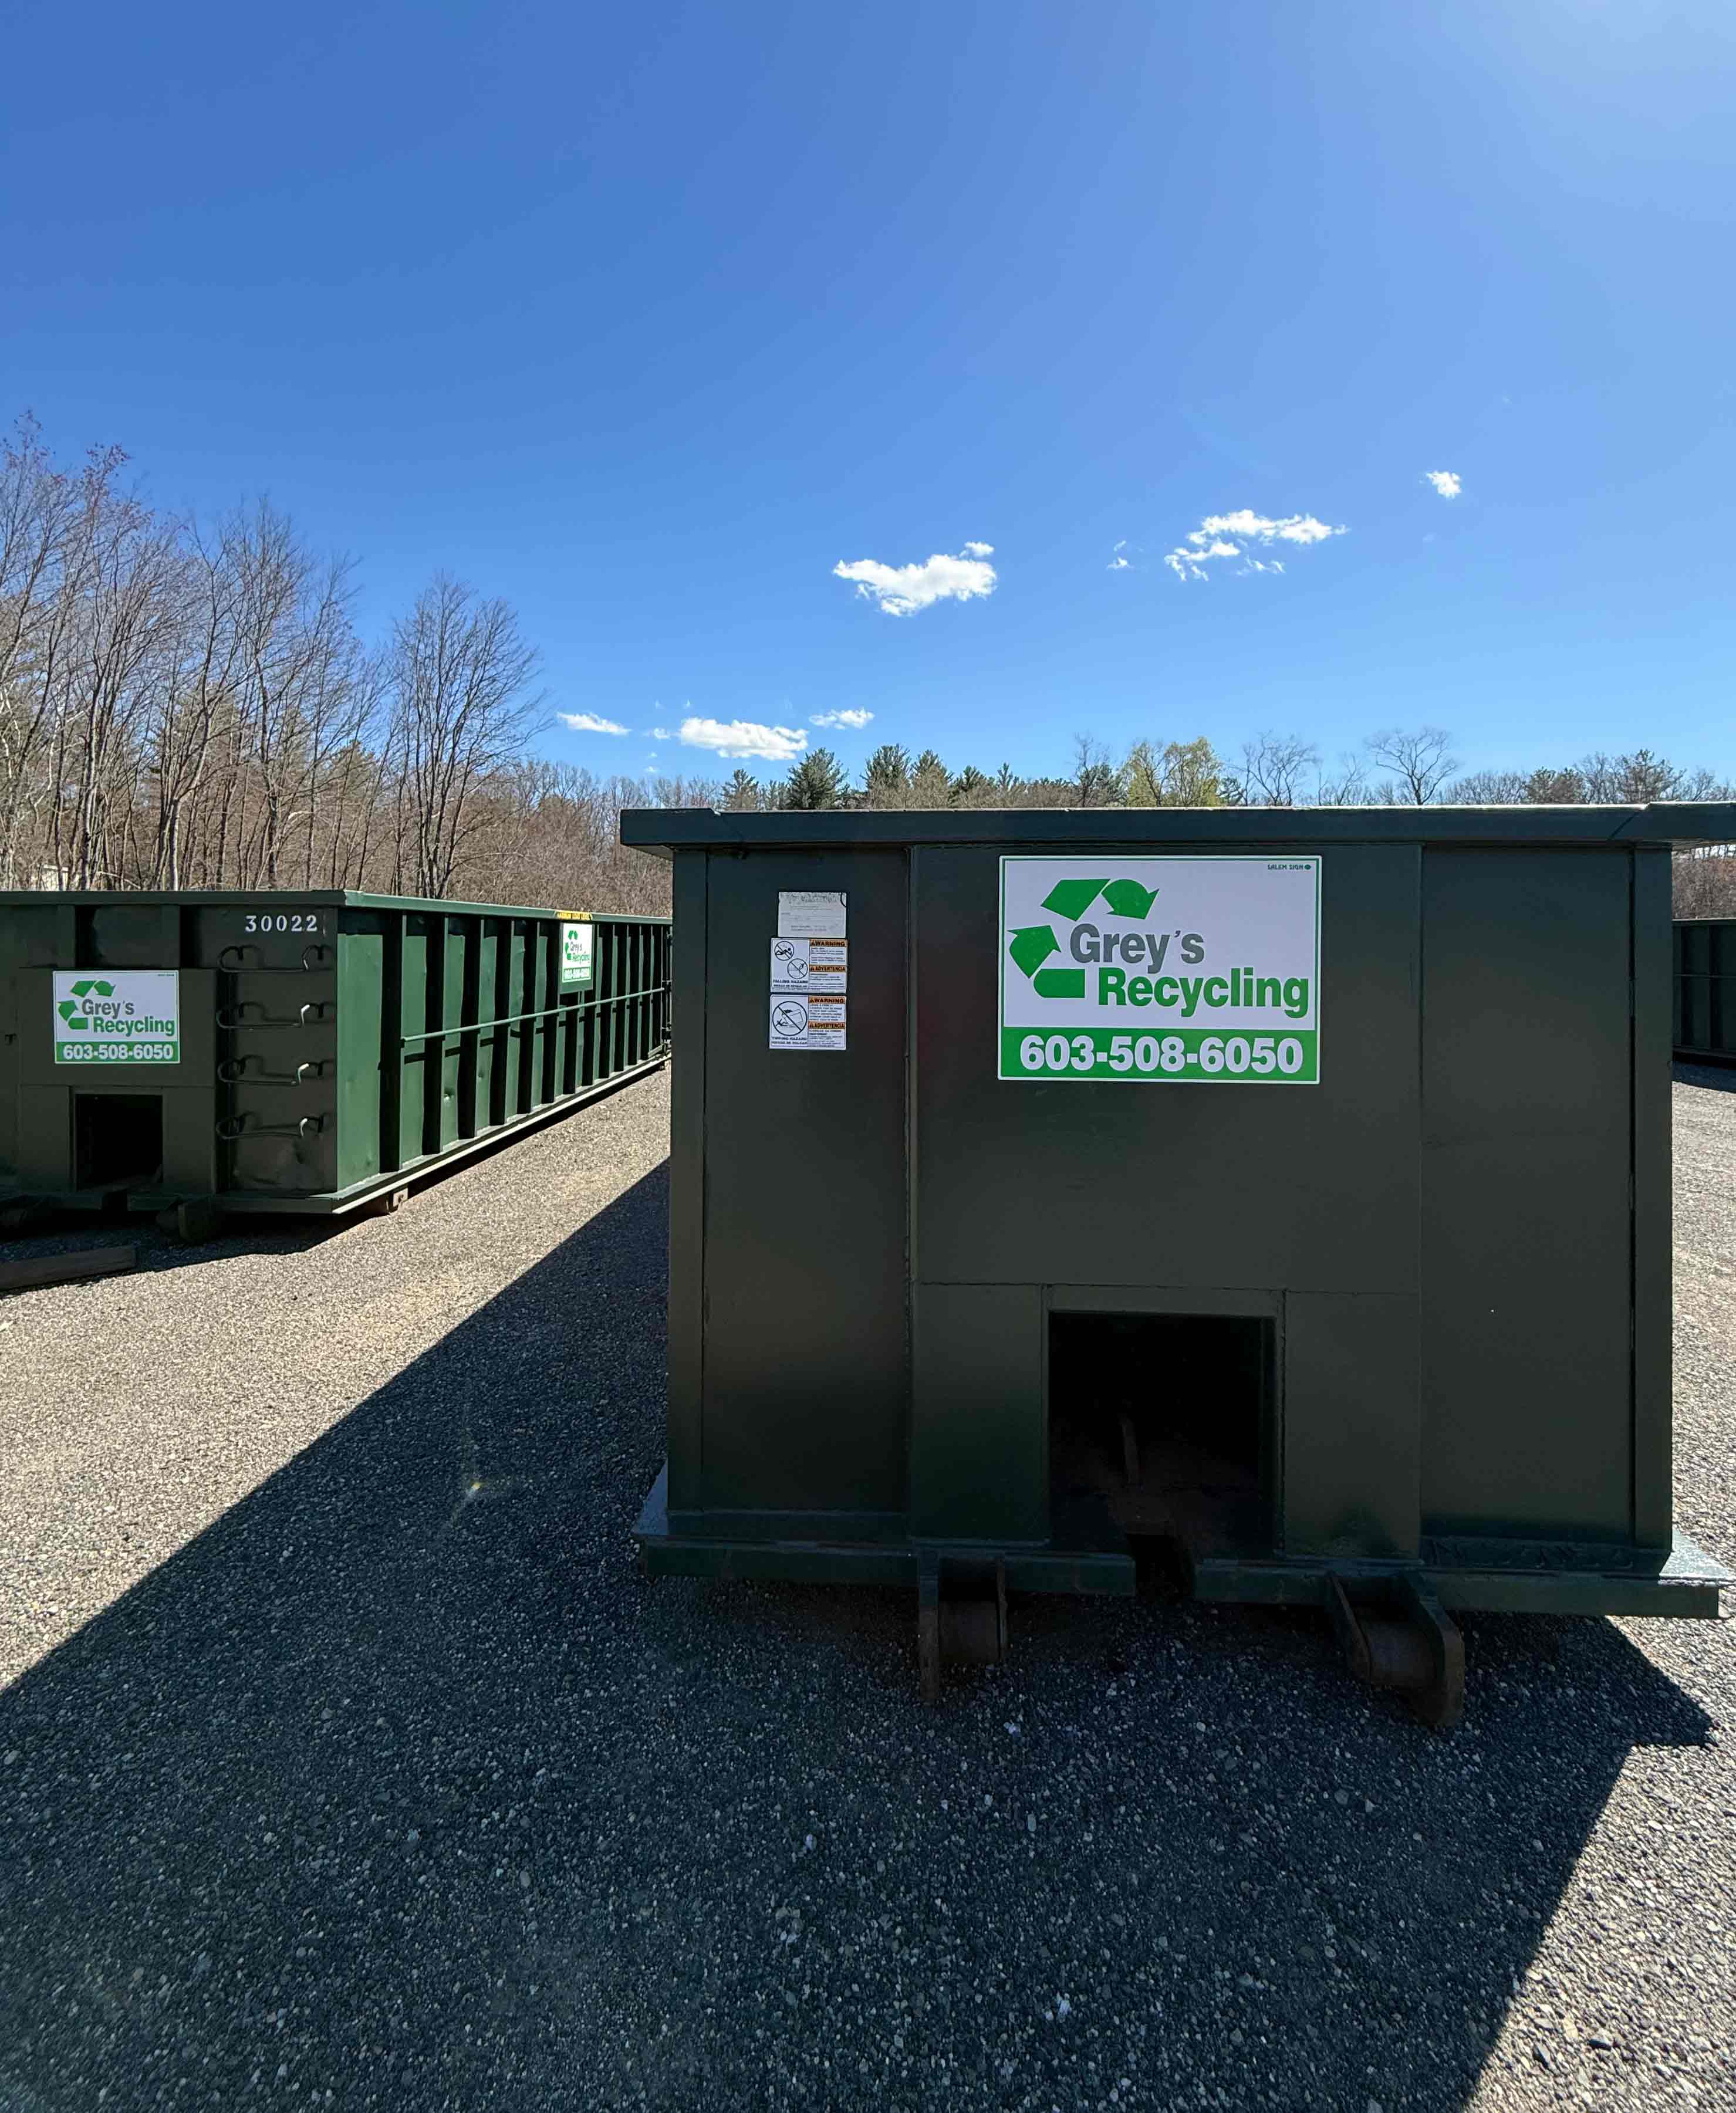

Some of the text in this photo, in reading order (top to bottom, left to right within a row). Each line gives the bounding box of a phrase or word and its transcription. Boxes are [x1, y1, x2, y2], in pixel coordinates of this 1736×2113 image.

[245, 915, 318, 932] 30022
[1070, 923, 1205, 974] Grey's
[1098, 967, 1309, 1019] Recycling
[82, 999, 134, 1019] Grey's
[93, 1015, 175, 1037] Recycling
[63, 1044, 173, 1060] 603-508-6050
[1020, 1034, 1303, 1073] 603-508-6050
